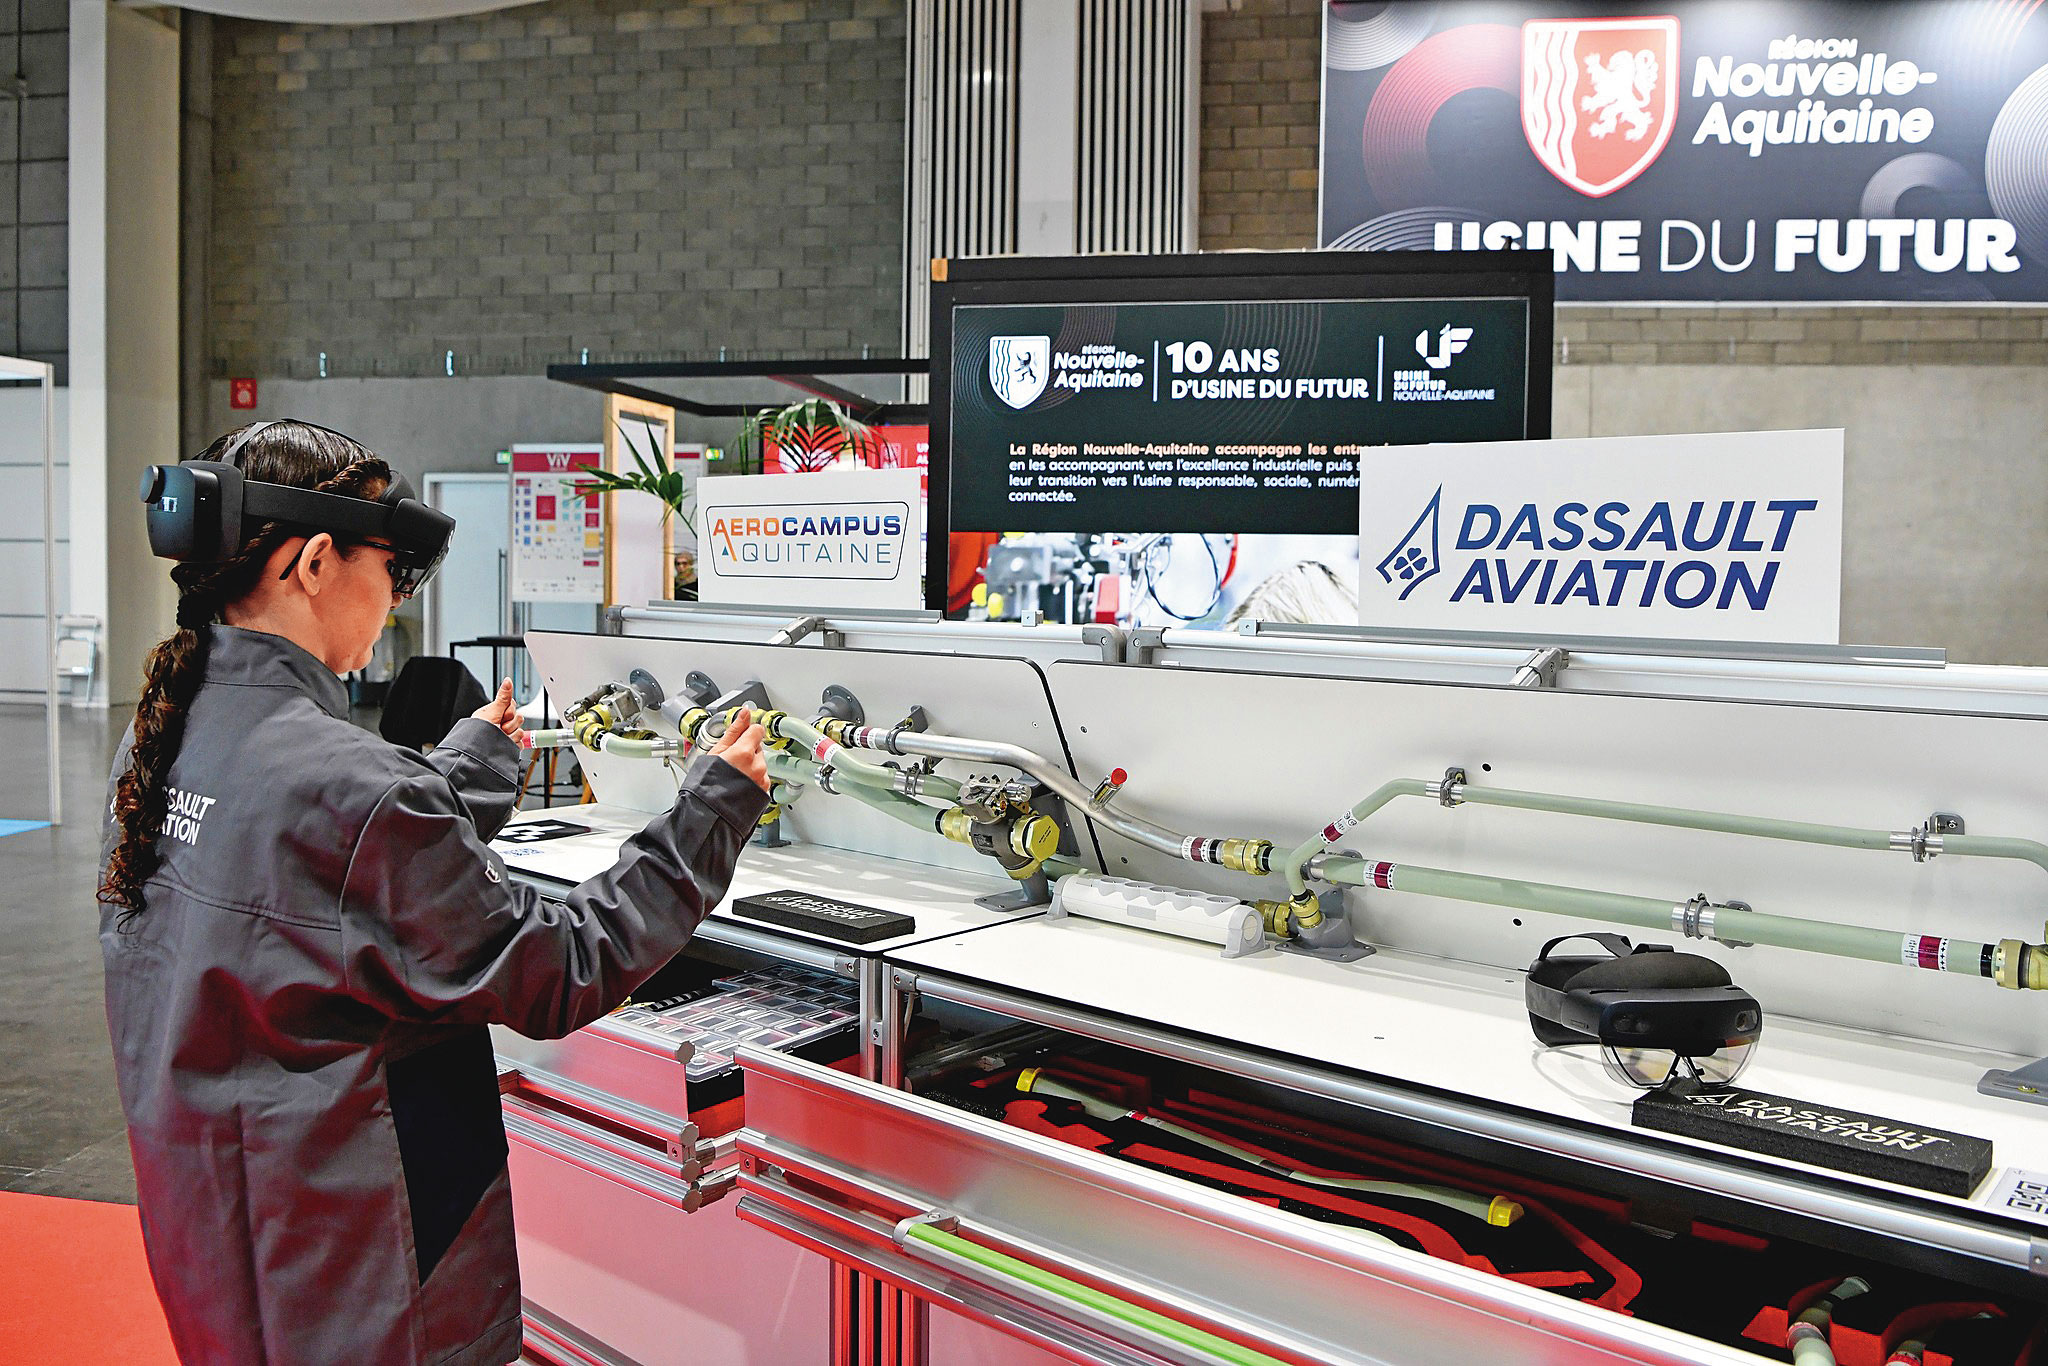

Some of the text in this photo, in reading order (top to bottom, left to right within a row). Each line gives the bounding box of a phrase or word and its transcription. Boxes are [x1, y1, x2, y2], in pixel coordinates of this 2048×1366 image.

[1768, 34, 1858, 60] RÉGION
[1692, 53, 1938, 97] Nouvelle-
[1692, 98, 1934, 157] Aquitaine
[1659, 220, 1756, 272] DU
[1774, 219, 2021, 273] FUTUR
[1053, 351, 1145, 370] Nouvelle-
[1165, 341, 1280, 374] 10 ANS
[1053, 369, 1144, 394] Aquitaine
[1171, 378, 1369, 399] D'USINE DU FUTUR
[1009, 443, 1026, 456] La
[1032, 443, 1077, 459] Région
[1083, 443, 1209, 458] Nouvelle-Aquitaine
[1214, 445, 1302, 458] accompagne
[1308, 443, 1328, 456] les
[1009, 461, 1025, 471] en
[1029, 459, 1046, 471] les
[1049, 460, 1145, 474] accompagnant
[1148, 461, 1173, 471] vers
[1176, 458, 1249, 472] l'excellence
[1252, 458, 1323, 471] industrielle
[1326, 458, 1353, 474] puis
[1009, 474, 1360, 489] leur transition vers l'usine responsable, sociale, numér
[1009, 489, 1077, 502] connectée.
[713, 515, 901, 540] AEROCAMPUS
[1455, 500, 1818, 551] DASSAULT
[1449, 559, 1780, 610] AVIATION
[162, 786, 216, 820] SAULT
[1725, 1107, 1923, 1150] AVIATION
[1737, 1100, 1950, 1144] DASSAULT
